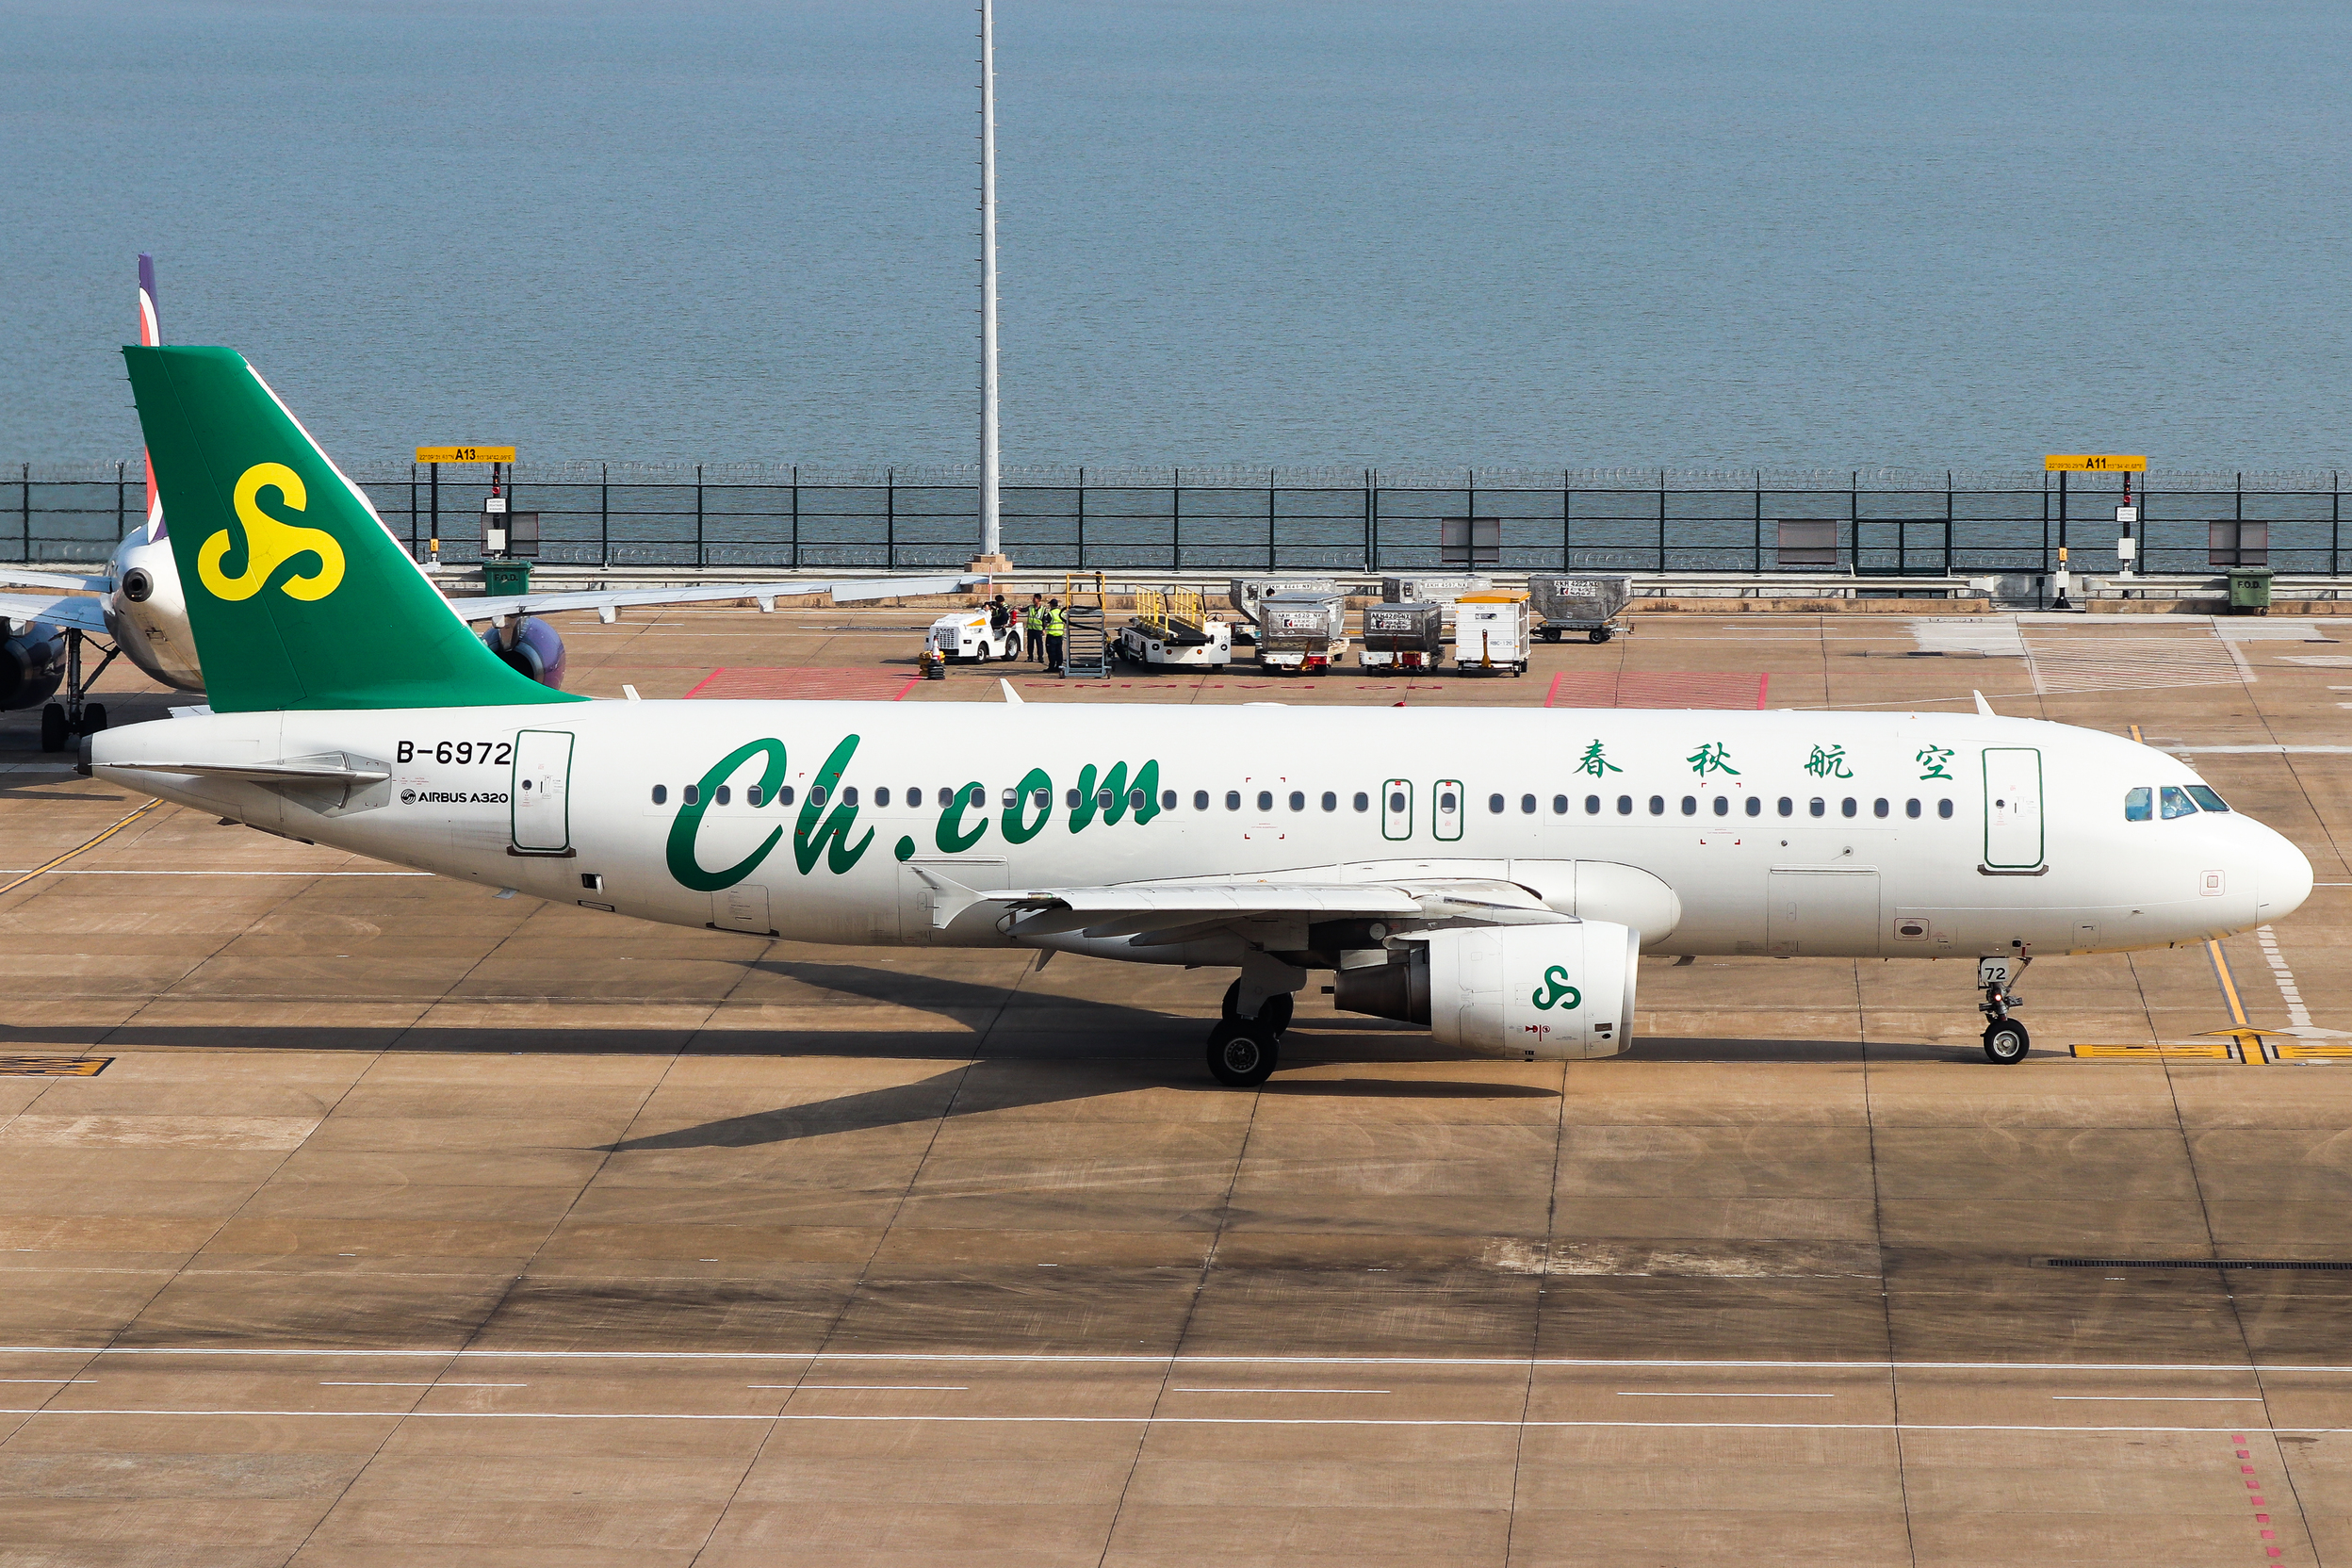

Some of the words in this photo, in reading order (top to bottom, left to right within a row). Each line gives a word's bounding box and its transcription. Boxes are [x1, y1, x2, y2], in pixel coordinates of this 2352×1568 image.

[455, 449, 476, 460] A13
[2085, 457, 2106, 469] A11
[2237, 580, 2262, 589] F.O.D.
[397, 740, 512, 765] B-6972
[1573, 738, 1956, 781] 春秋航空
[417, 792, 467, 803] AIRBUS
[469, 793, 509, 804] A320
[666, 734, 1161, 891] Ch.com
[1984, 967, 2006, 981] 72
